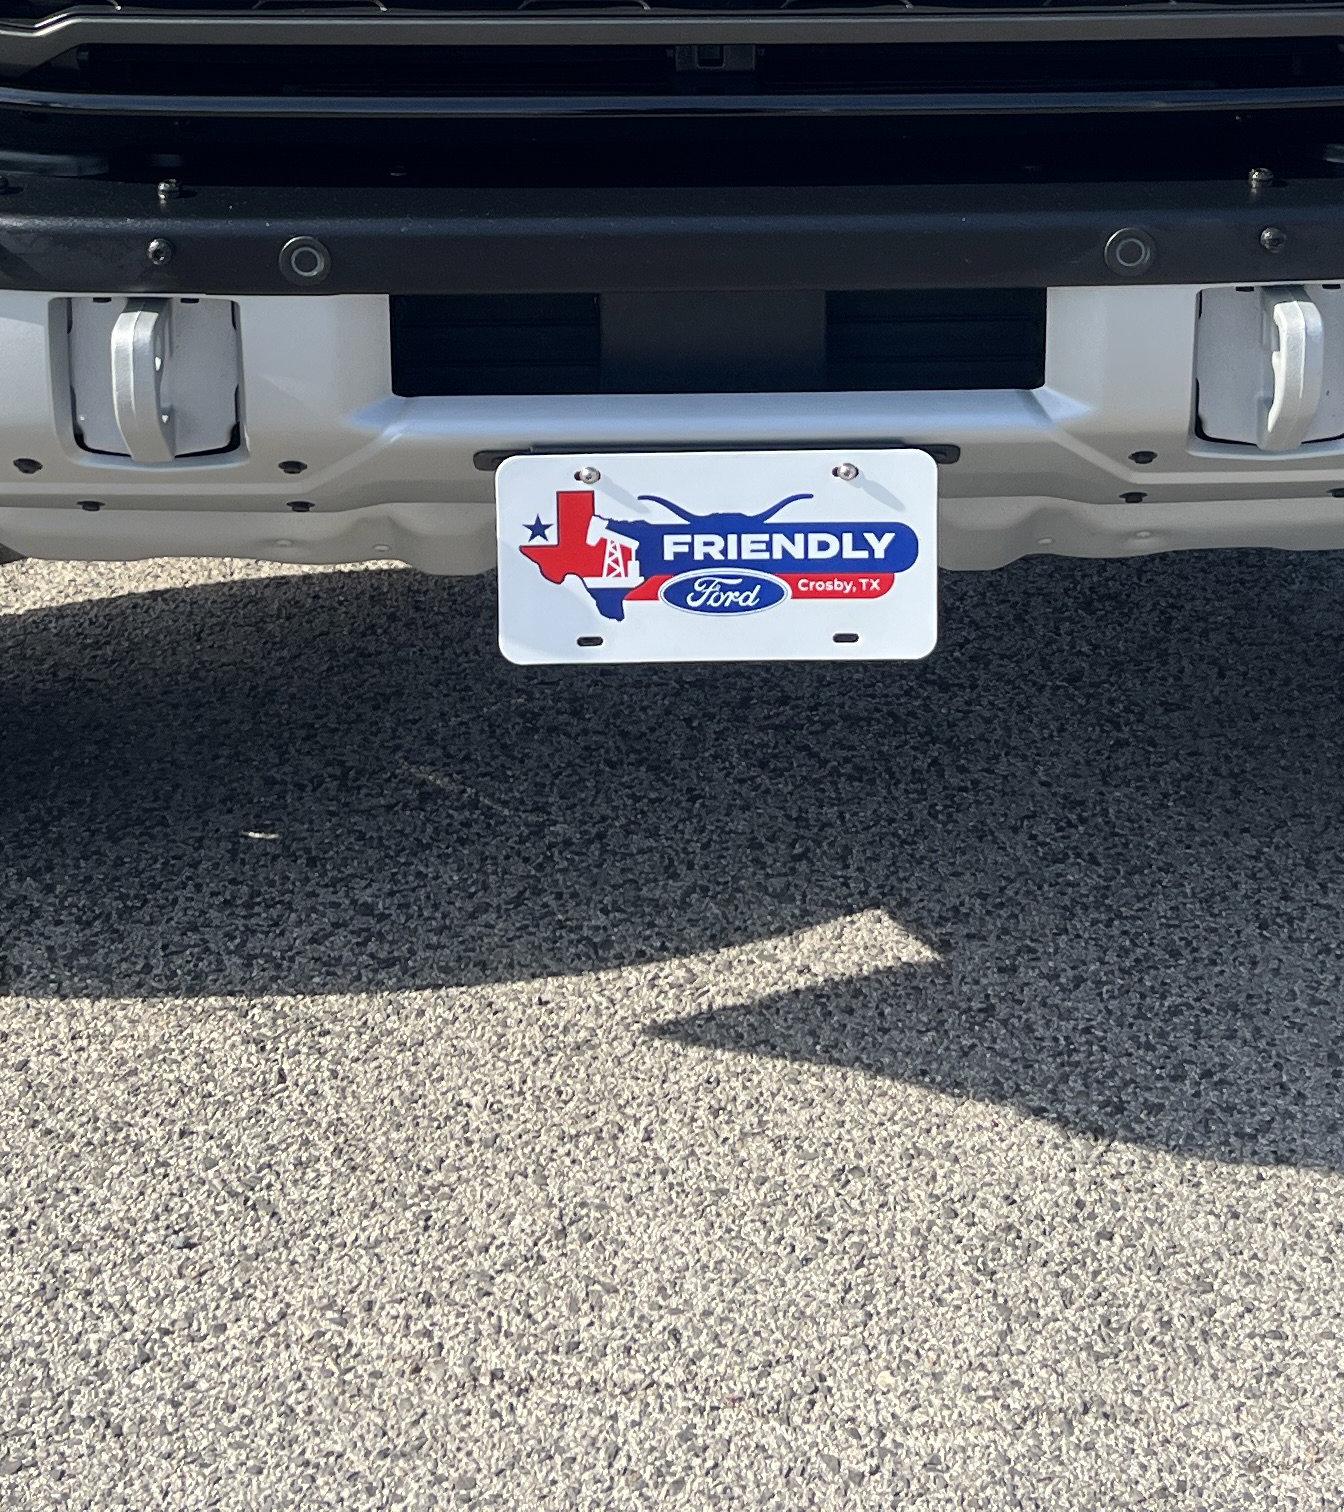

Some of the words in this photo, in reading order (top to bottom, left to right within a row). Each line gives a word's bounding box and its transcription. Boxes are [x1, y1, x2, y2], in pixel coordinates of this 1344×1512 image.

[663, 532, 896, 561] FRIENDLY
[686, 575, 761, 609] Ford
[797, 578, 857, 594] Crosby,
[859, 578, 881, 591] TX
